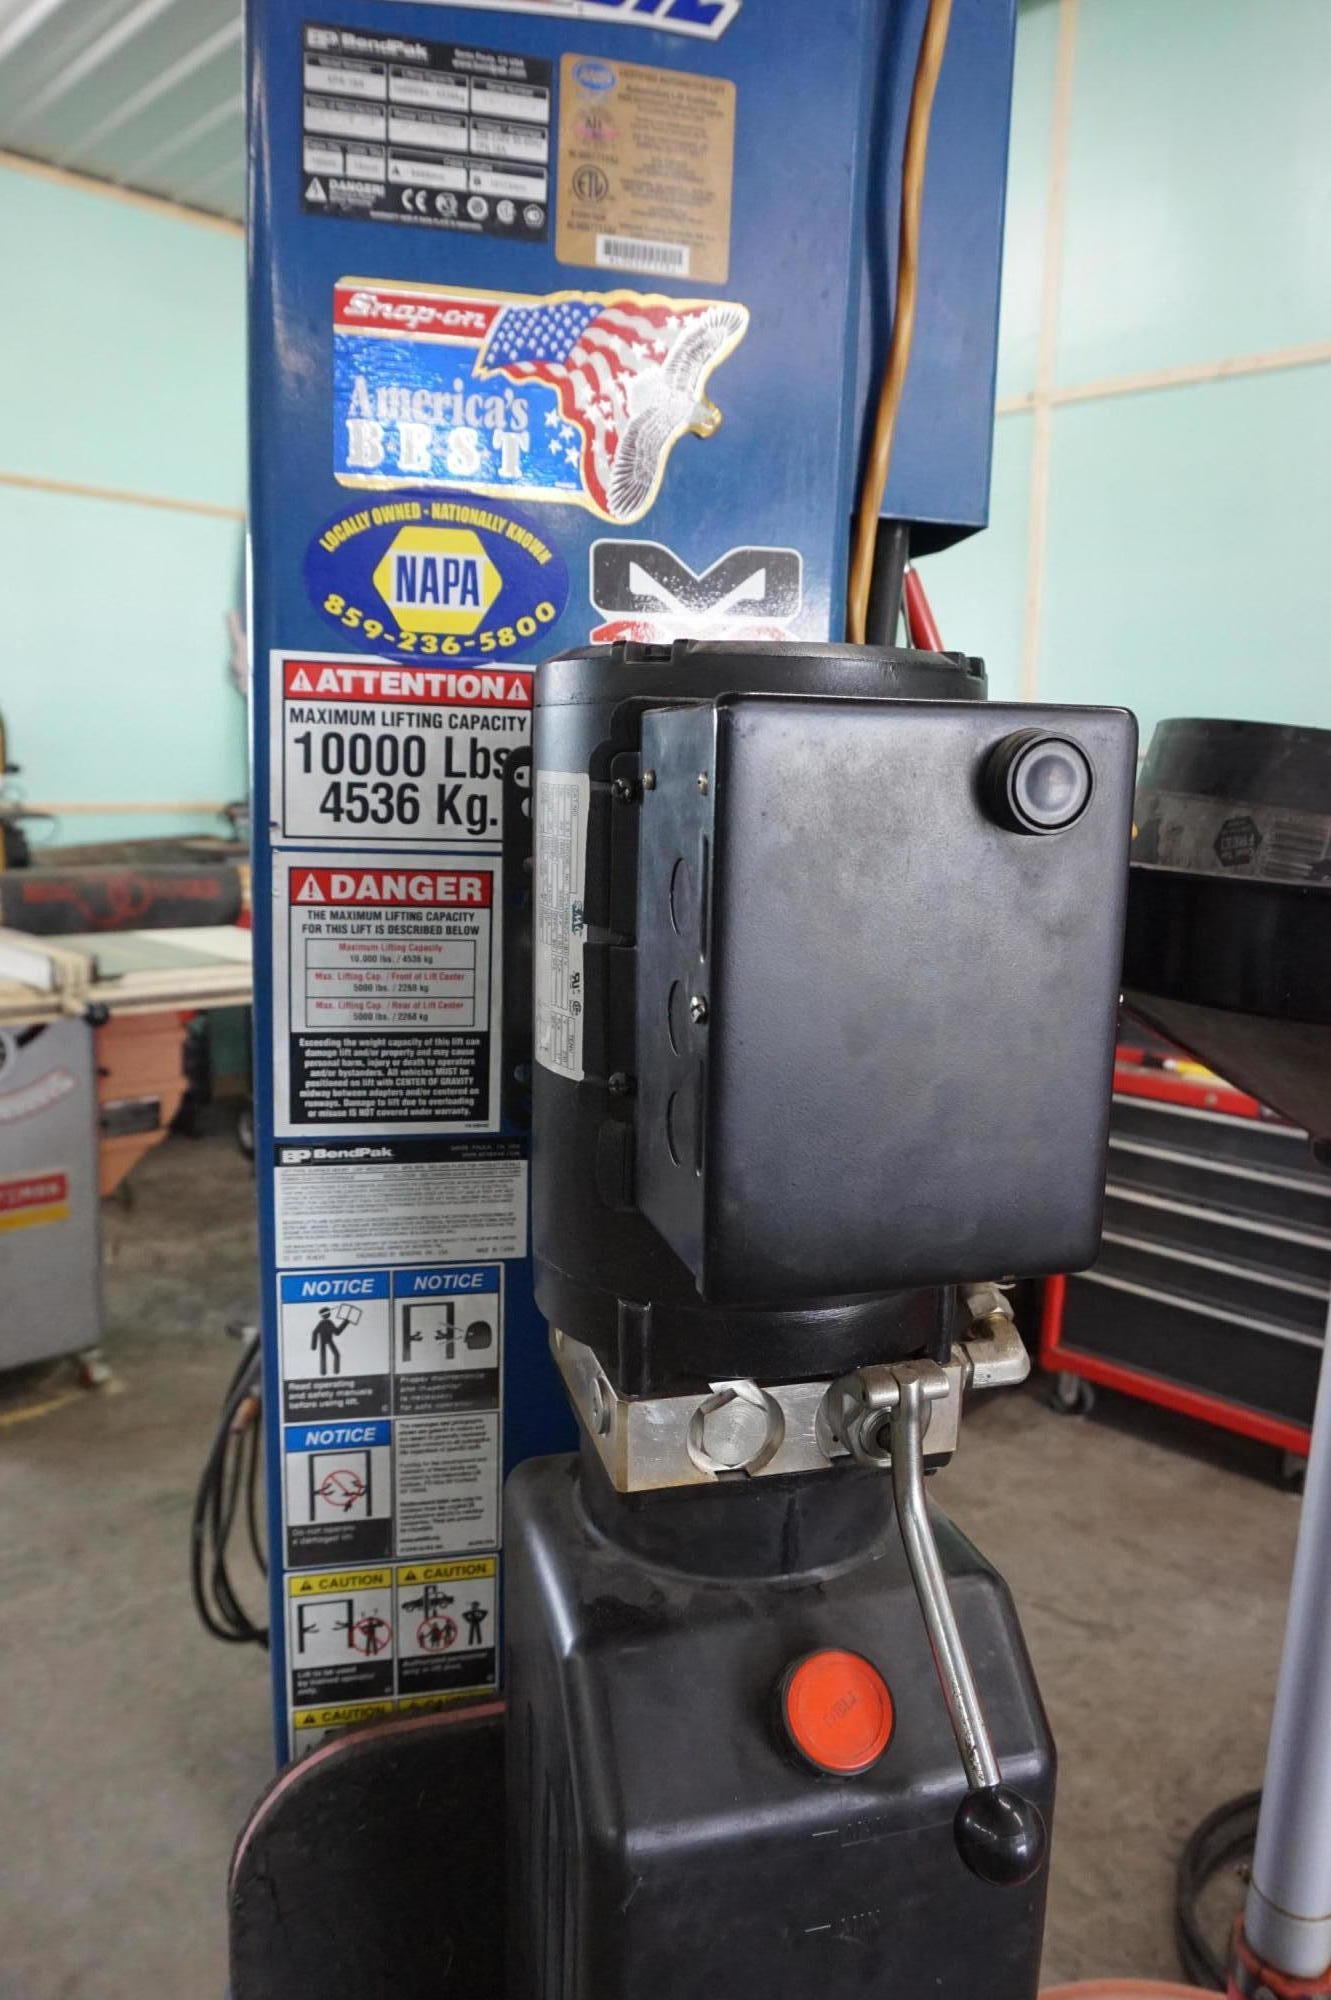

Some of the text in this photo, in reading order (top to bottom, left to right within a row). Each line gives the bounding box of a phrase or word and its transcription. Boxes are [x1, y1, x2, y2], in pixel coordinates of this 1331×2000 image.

[341, 32, 428, 61] BendPak
[343, 292, 486, 330] Snap-on
[348, 375, 528, 430] America's
[345, 418, 530, 478] BEST
[319, 501, 553, 565] LOCALLY OWNED NATIONALLY KNOWN
[395, 554, 481, 608] NAPA
[323, 593, 556, 655] 859-236-5800
[315, 668, 505, 700] ATTENTION
[289, 707, 527, 732] MAXIMUM LIFTING CAPACITY
[293, 731, 426, 778] 10000
[319, 781, 498, 835] 4536 Kg.
[330, 874, 482, 902] DANGER
[308, 910, 474, 922] THE MAXIMUM LIFTING CAPACITY
[302, 924, 480, 936] FOR THIS LIFT IS DESCRIBED BELOW
[338, 943, 443, 953] Maximum Lifting Capacity
[338, 972, 363, 981] Lifting
[395, 1078, 426, 1087] CENTER
[428, 1077, 438, 1086] OF
[440, 1077, 473, 1086] GRAVITY
[313, 1147, 393, 1159] BendPak
[301, 1278, 375, 1296] NOTICE
[414, 1273, 484, 1290] NOTICE
[305, 1427, 376, 1446] NOTICE
[318, 1574, 383, 1590] CAUTION
[423, 1563, 487, 1580] CAUTION
